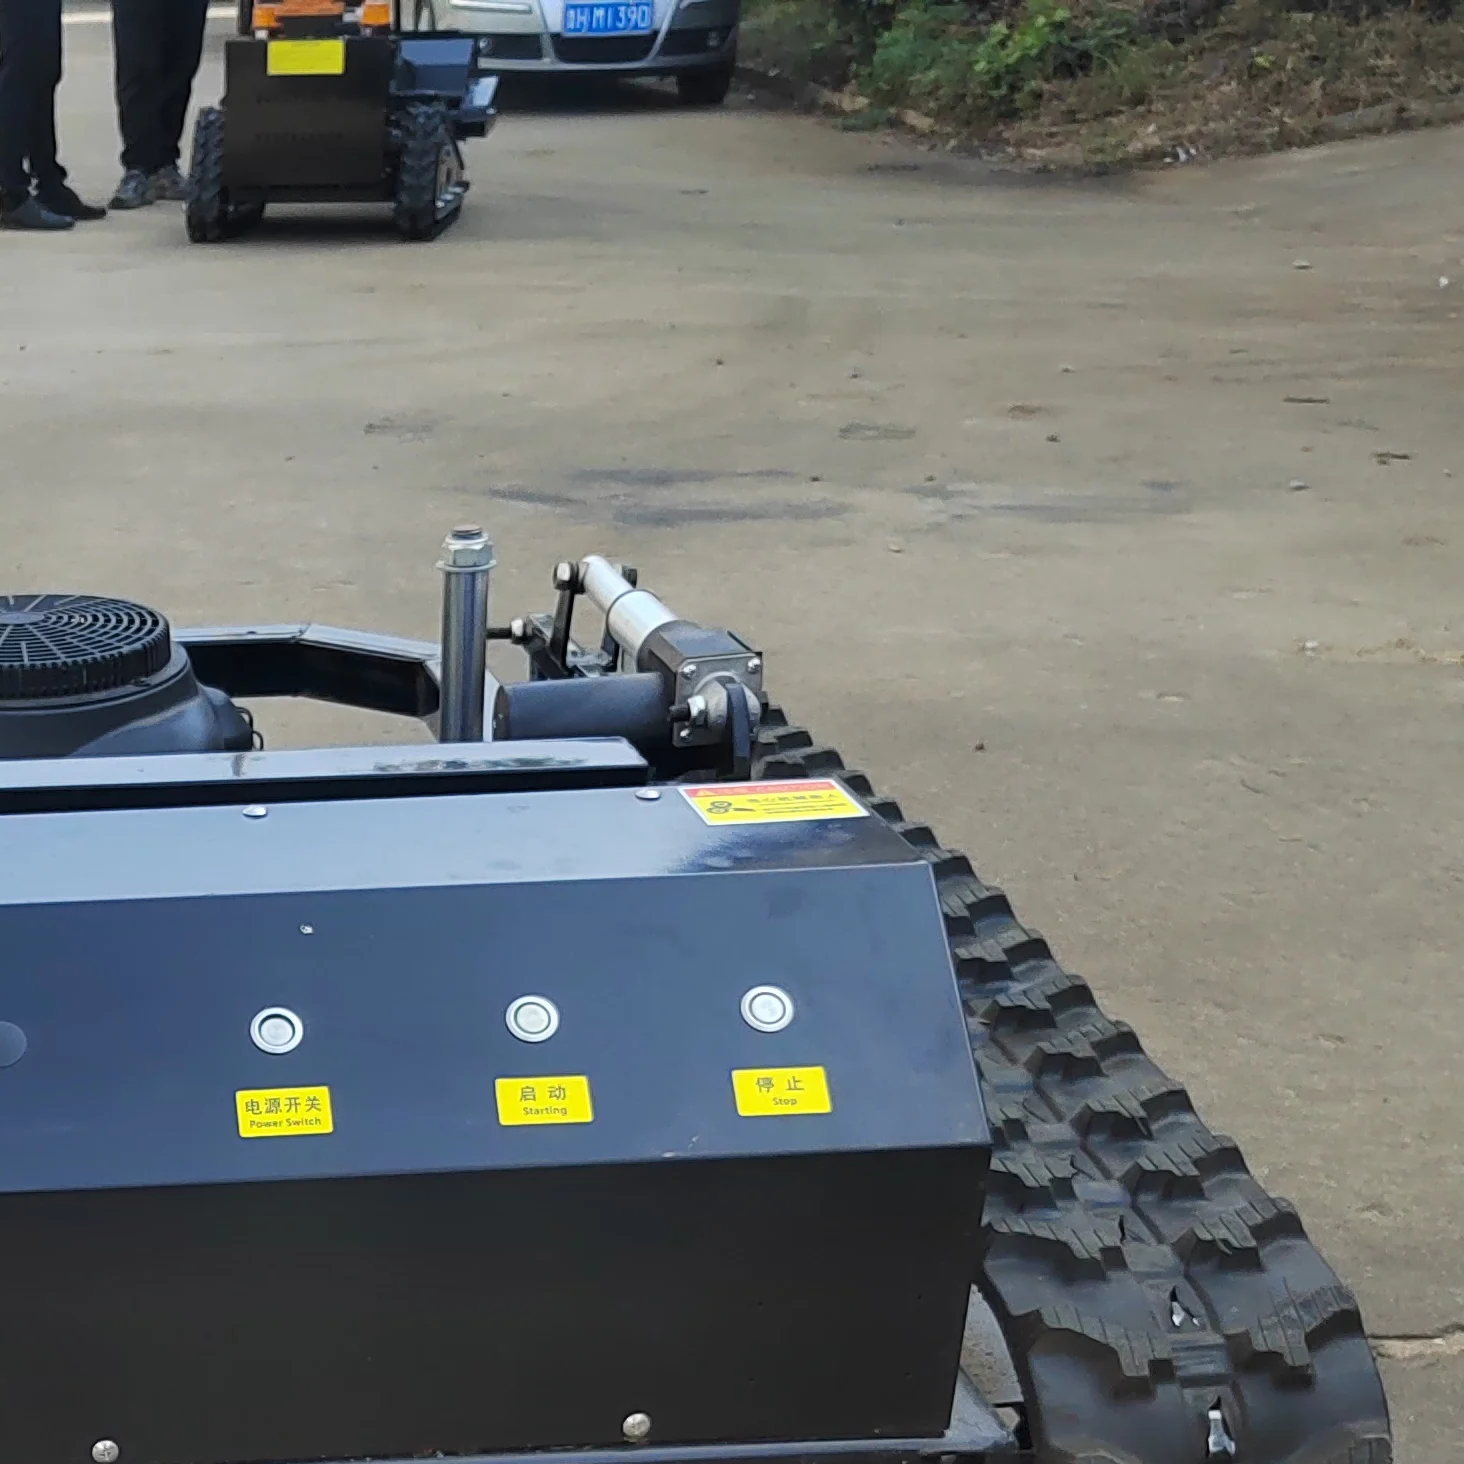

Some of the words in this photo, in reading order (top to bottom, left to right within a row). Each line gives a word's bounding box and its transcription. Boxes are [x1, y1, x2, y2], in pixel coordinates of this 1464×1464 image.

[755, 1075, 805, 1093] 停止
[519, 1083, 567, 1102] 启动
[244, 1095, 322, 1115] 电源开关
[772, 1096, 798, 1107] Stop
[522, 1105, 568, 1117] Starting
[249, 1119, 283, 1129] Power
[285, 1116, 322, 1128] Switch
